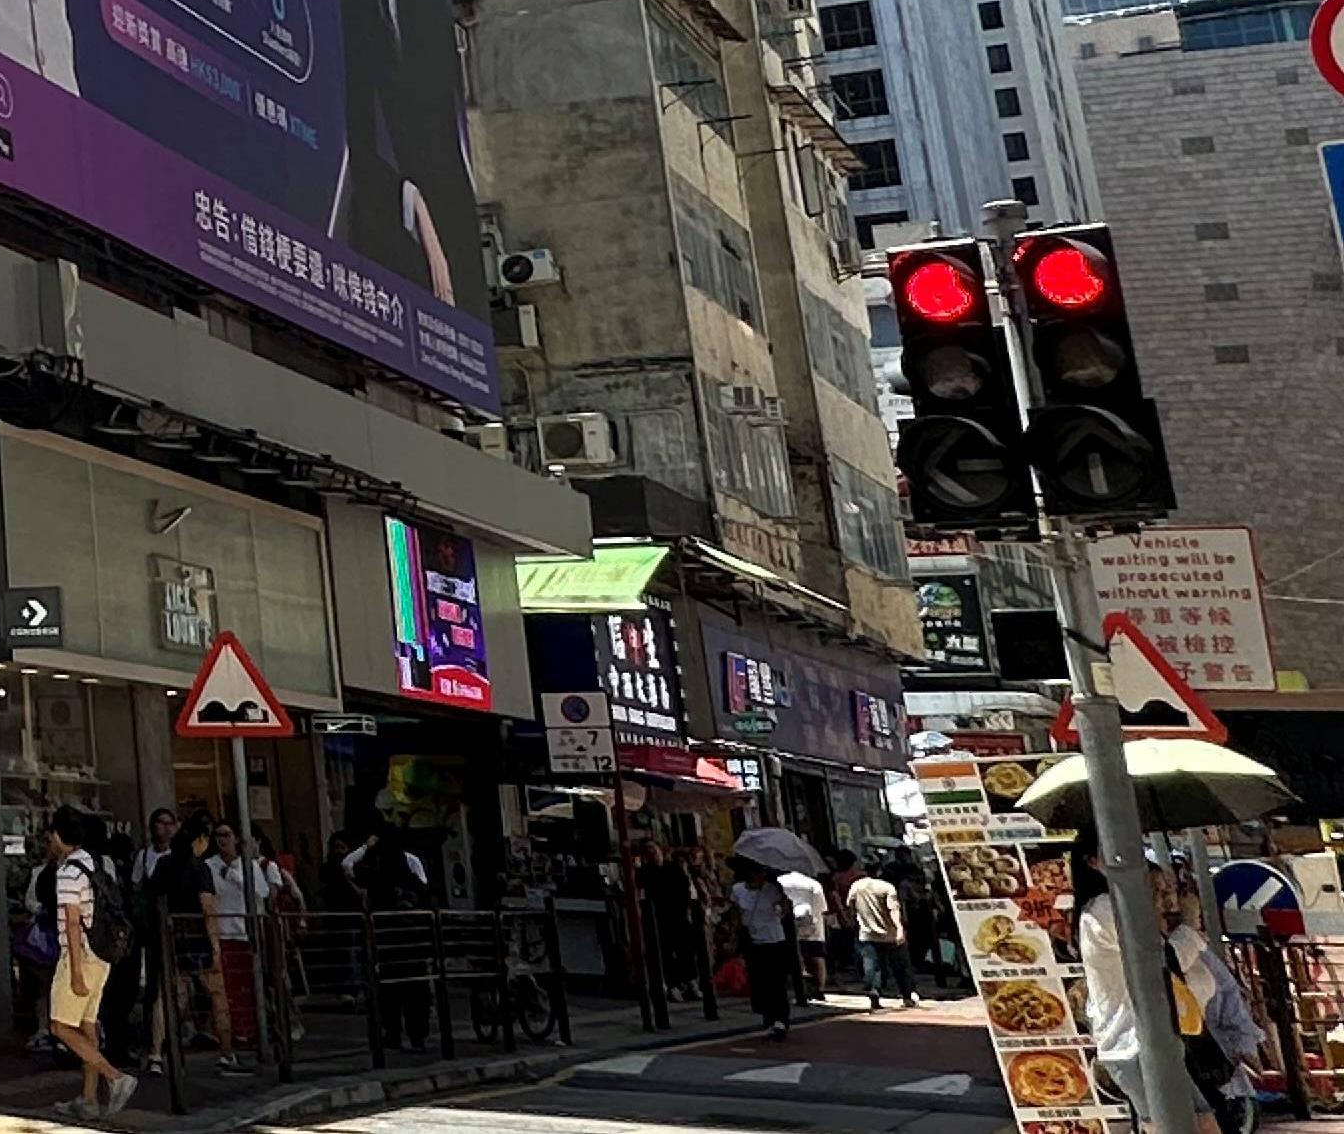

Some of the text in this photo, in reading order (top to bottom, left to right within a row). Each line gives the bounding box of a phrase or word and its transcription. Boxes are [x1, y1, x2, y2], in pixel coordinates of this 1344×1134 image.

[1130, 535, 1200, 549] Vehicle
[1102, 552, 1235, 567] waiting will be
[1118, 569, 1224, 584] prosecuted
[1097, 586, 1252, 601] without warning
[1156, 634, 1236, 654] 被檢控
[587, 730, 598, 746] 7
[593, 756, 612, 772] 12
